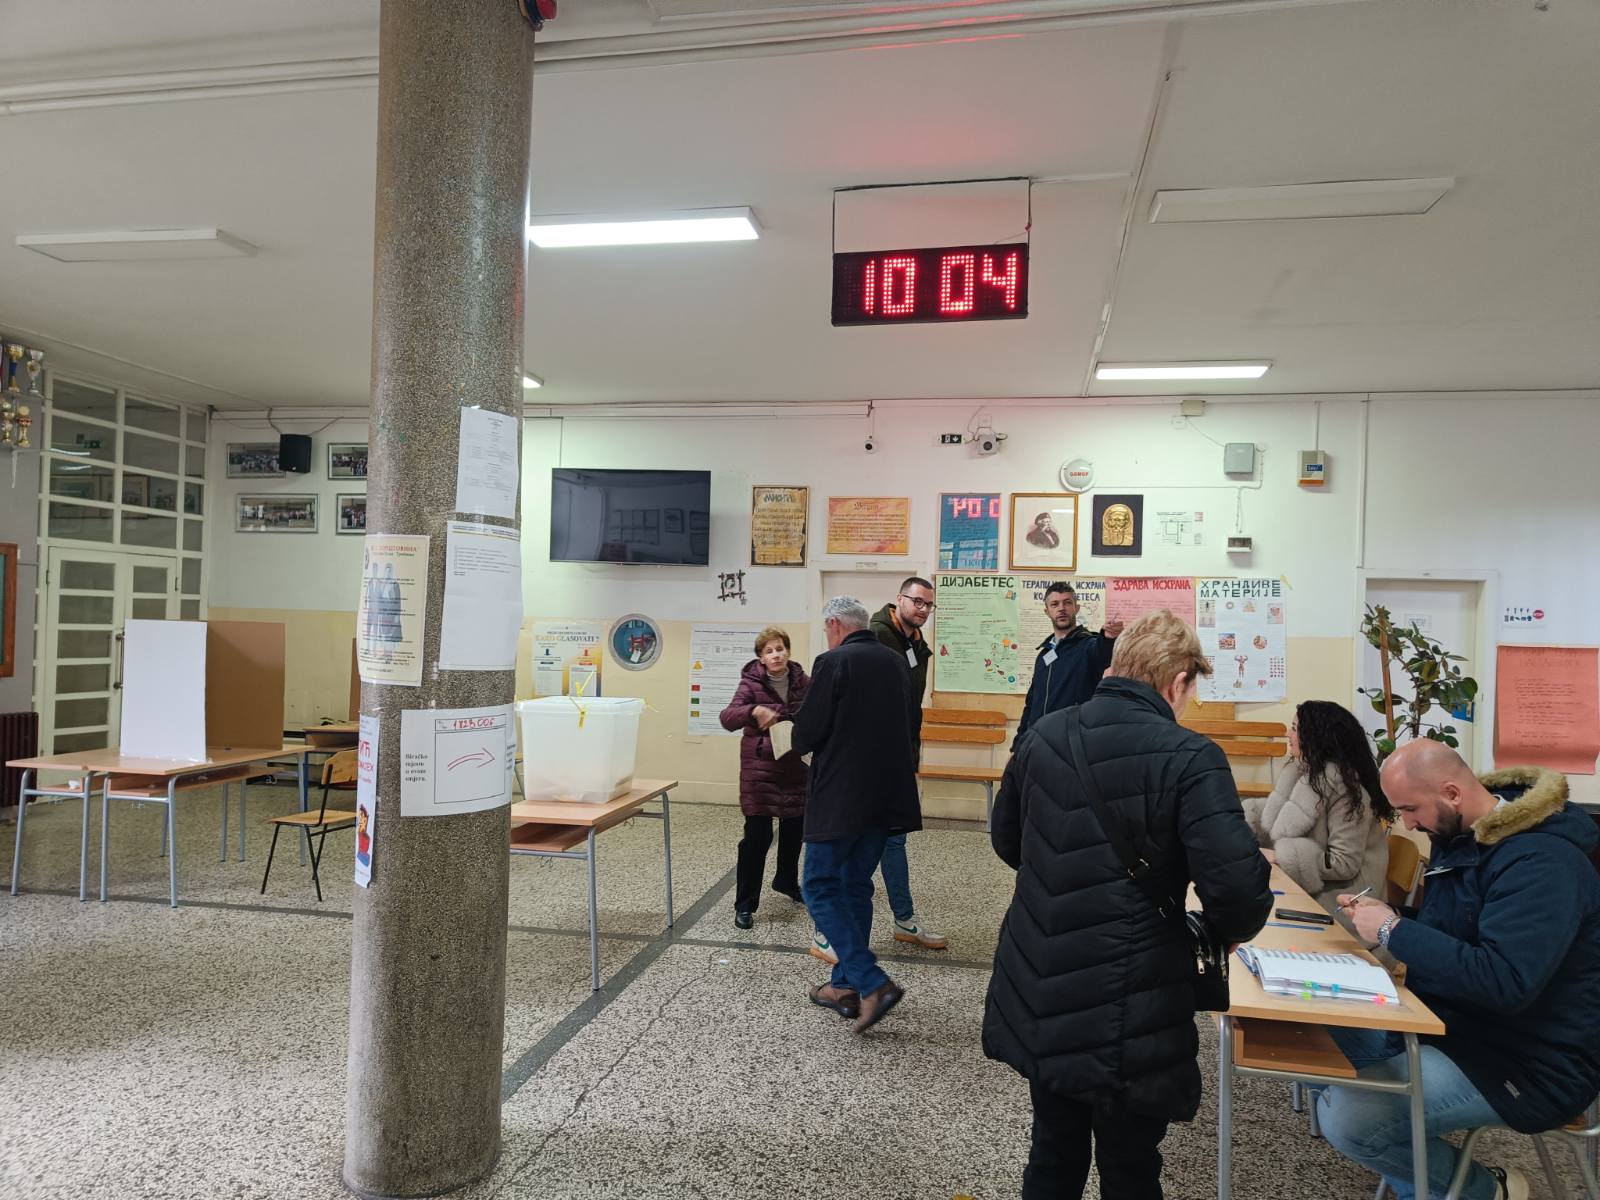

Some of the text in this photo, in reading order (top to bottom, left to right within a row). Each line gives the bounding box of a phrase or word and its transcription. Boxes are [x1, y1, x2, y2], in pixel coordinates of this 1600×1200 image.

[864, 251, 1018, 315] 10 04
[939, 576, 1015, 588] ДИЈАБЕТЕС
[1113, 579, 1191, 592] ЗДРАВА ИСХРАНА
[1200, 588, 1281, 598] МАТЕРИЈЕ
